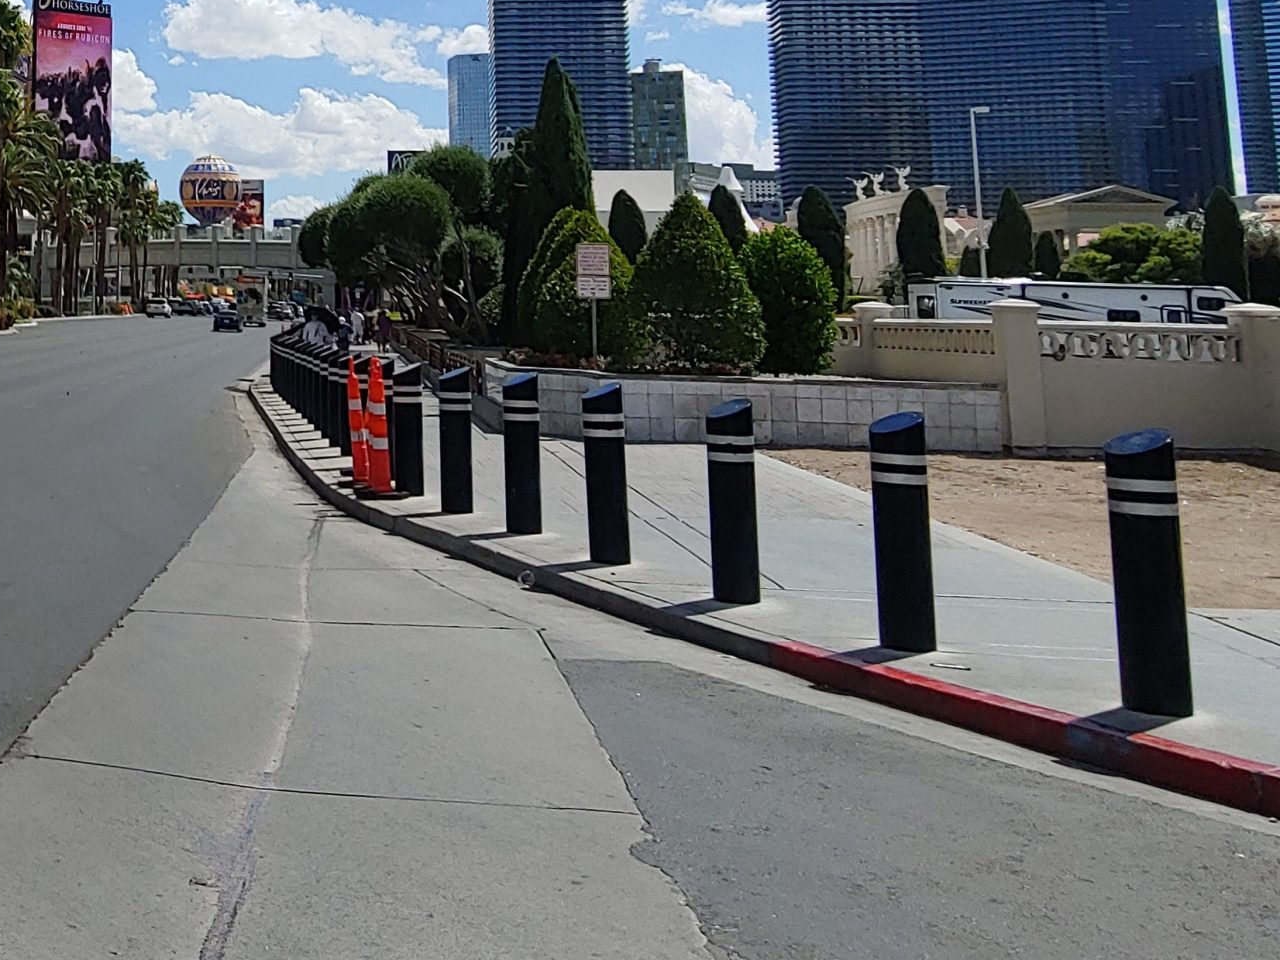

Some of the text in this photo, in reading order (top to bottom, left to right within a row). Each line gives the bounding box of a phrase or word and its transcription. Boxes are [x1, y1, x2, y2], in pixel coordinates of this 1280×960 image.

[38, 28, 110, 45] FIRES OF RUBICON
